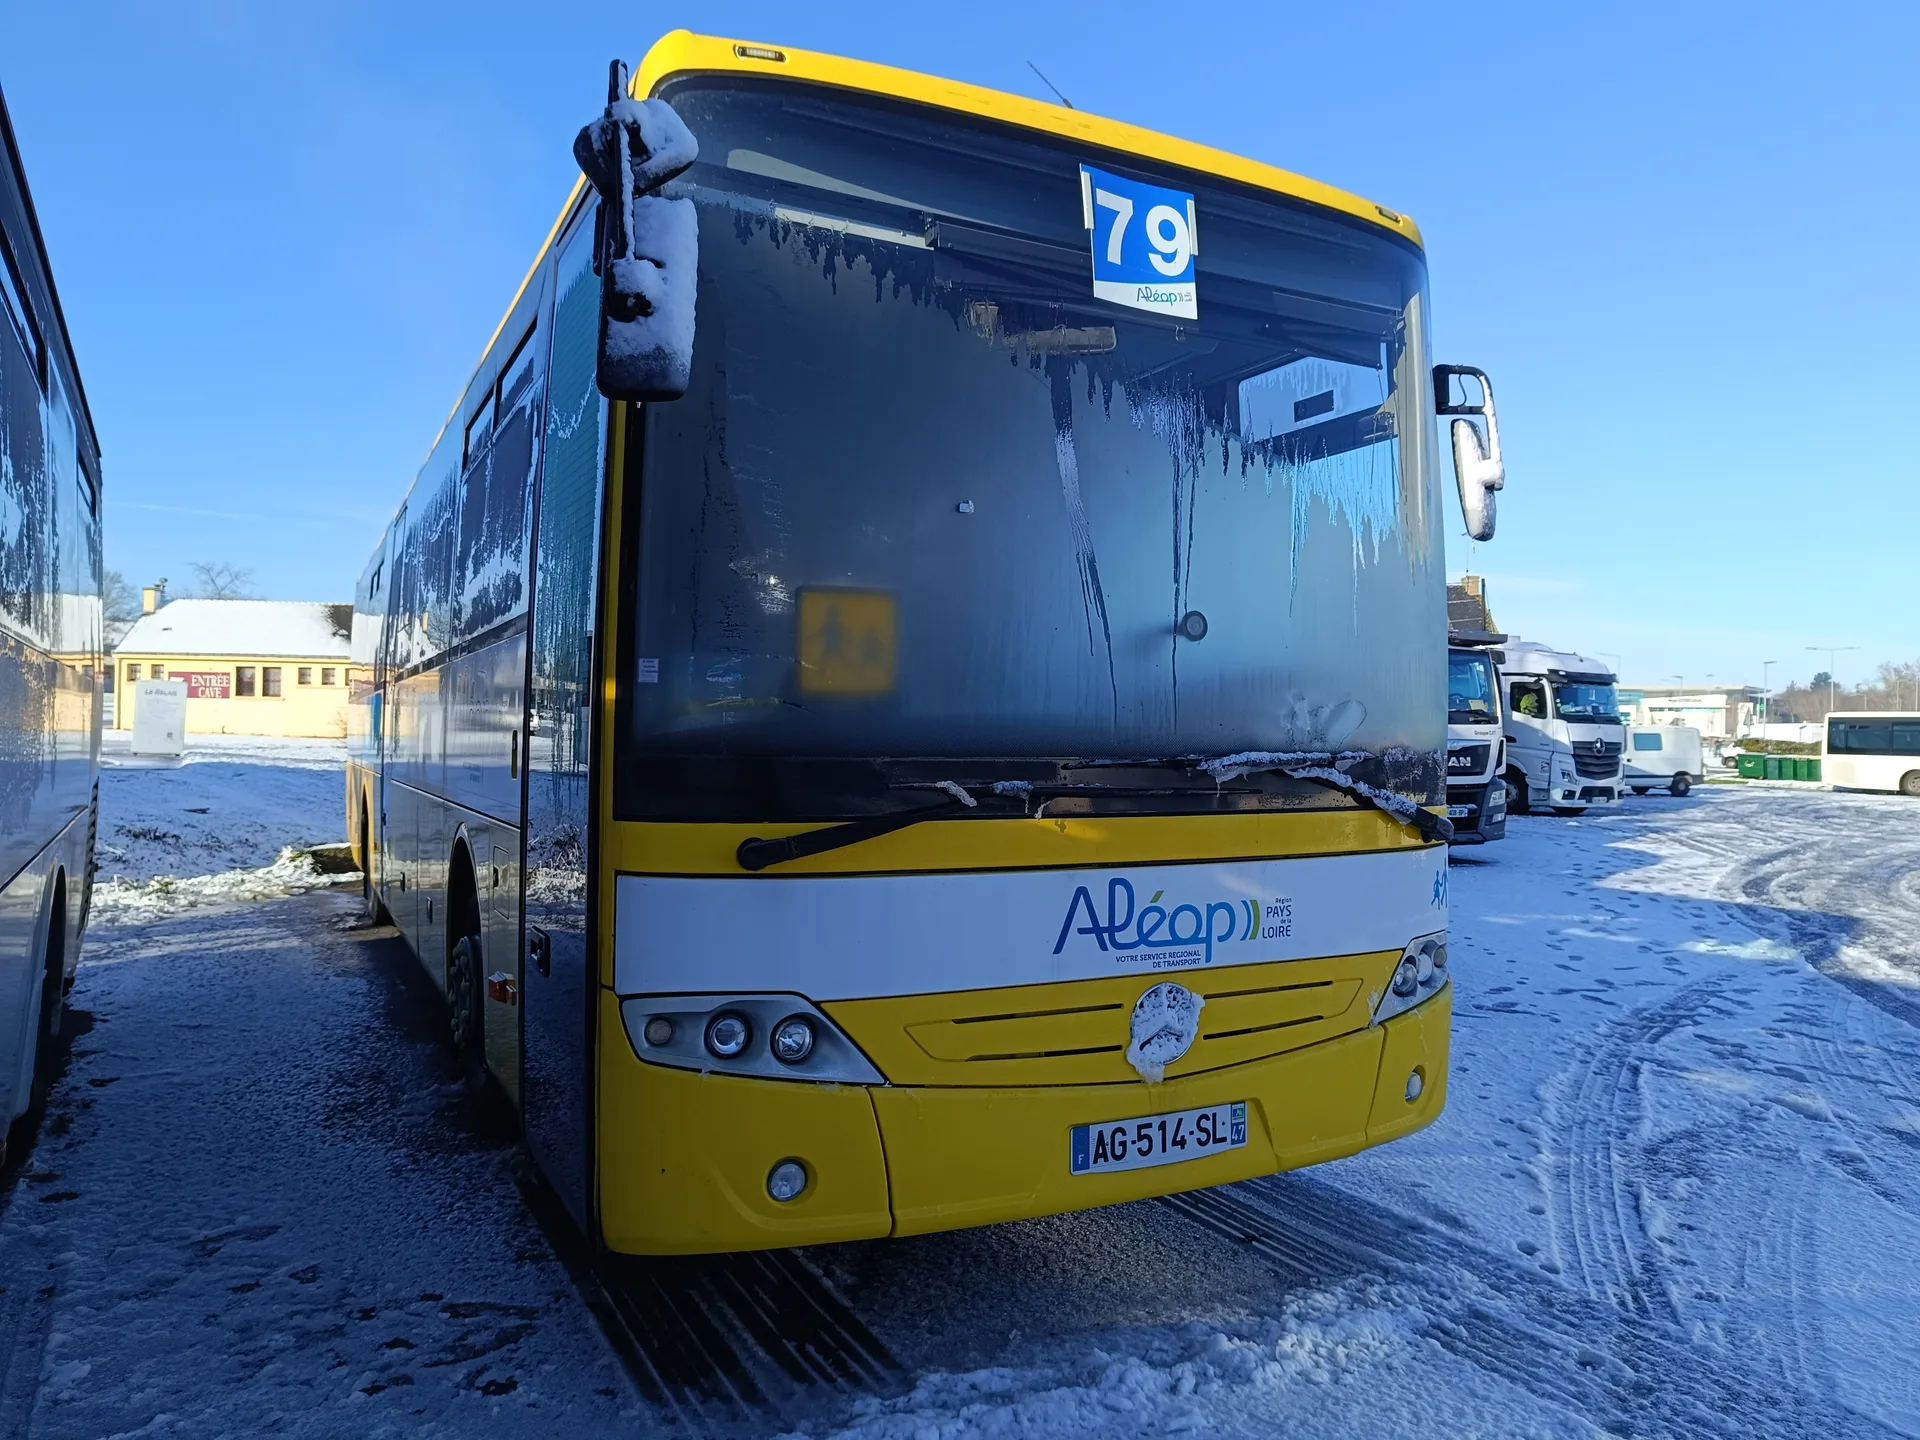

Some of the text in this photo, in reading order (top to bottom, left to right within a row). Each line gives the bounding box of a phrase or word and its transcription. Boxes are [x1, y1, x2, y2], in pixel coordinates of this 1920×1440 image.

[1096, 188, 1190, 277] 79
[1137, 286, 1177, 306] Aléop
[191, 674, 230, 687] ENTRÉE
[198, 687, 222, 698] CAVE
[1447, 756, 1471, 767] AN
[1266, 904, 1291, 918] PAYS
[1052, 878, 1237, 963] Aléop
[1262, 924, 1291, 939] LOIRE
[1115, 949, 1201, 963] VOTRE SERVICE REGIONAL
[1163, 957, 1201, 967] TRANSPORT
[1092, 1112, 1245, 1165] AG-514-SL 47
[1078, 1153, 1085, 1165] F
